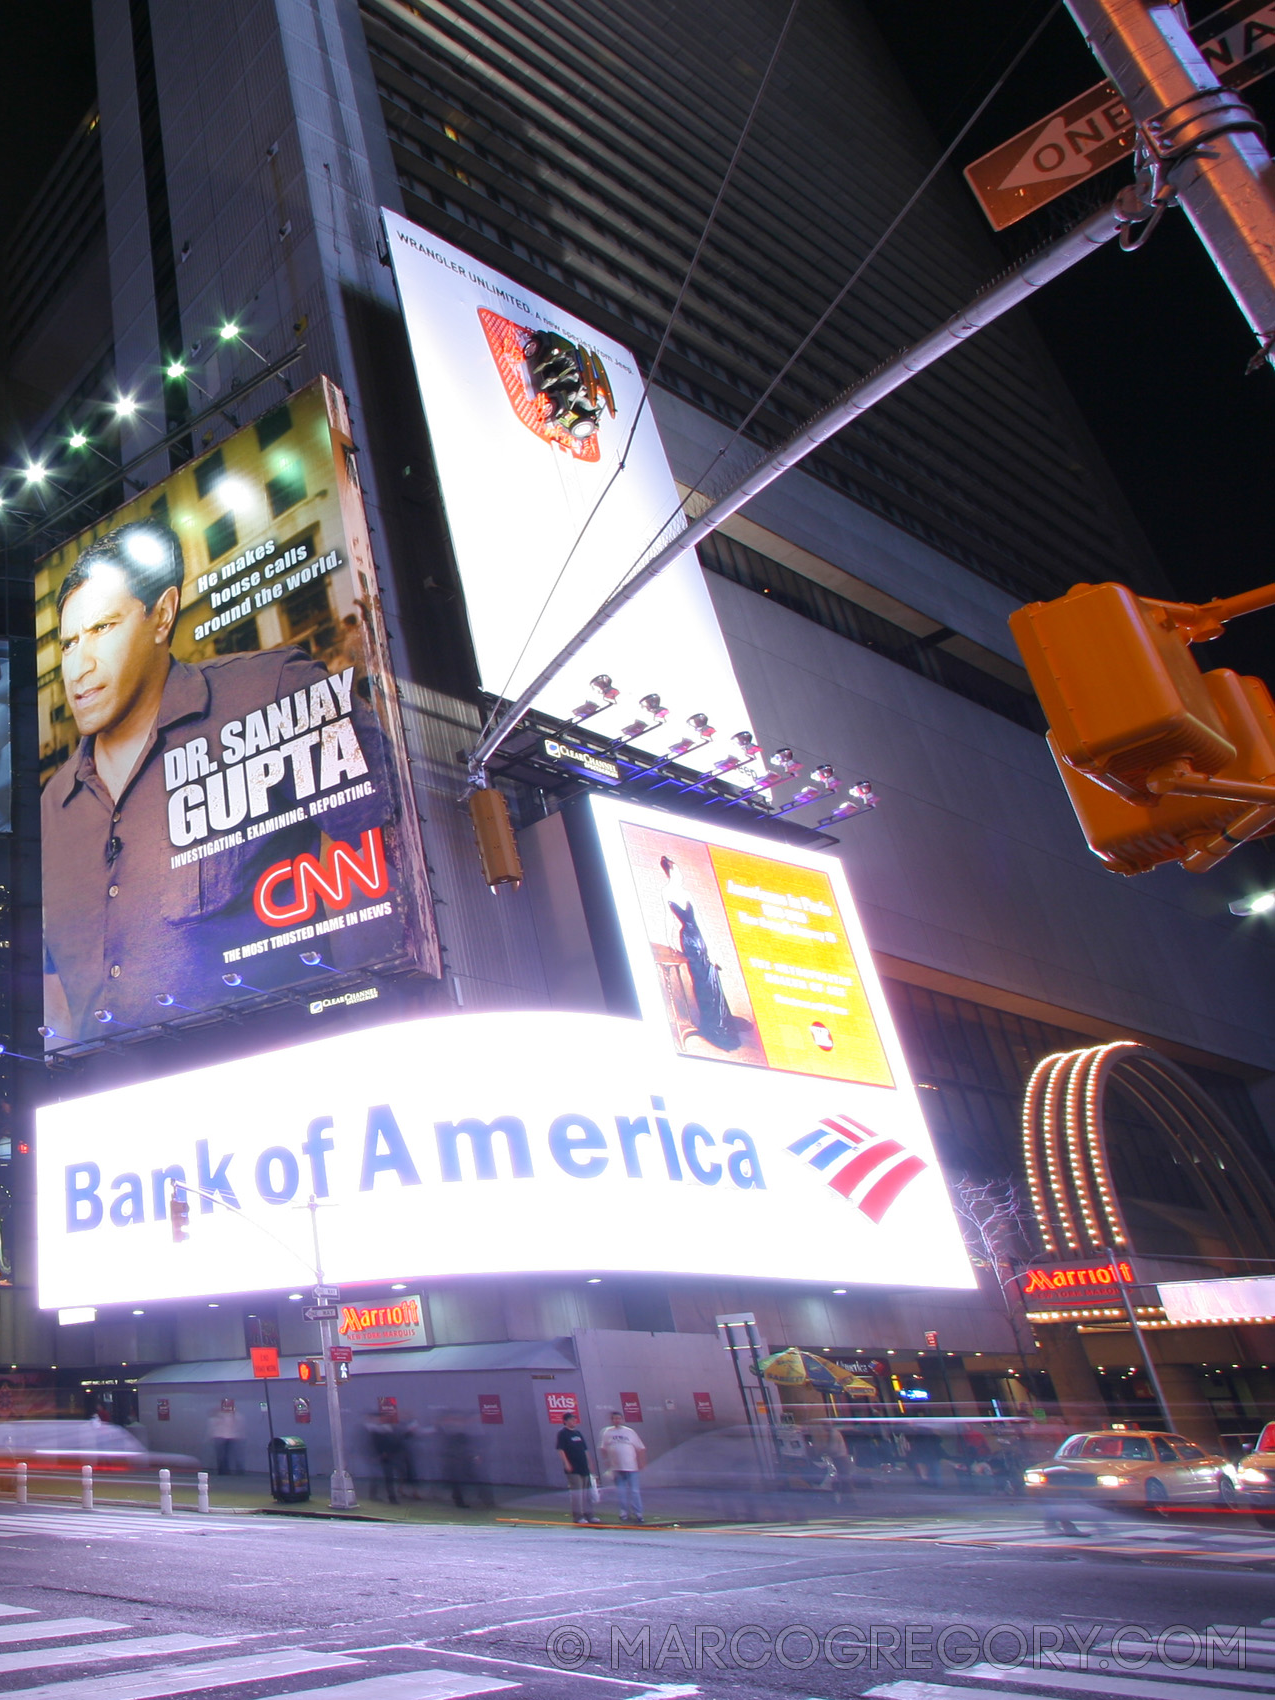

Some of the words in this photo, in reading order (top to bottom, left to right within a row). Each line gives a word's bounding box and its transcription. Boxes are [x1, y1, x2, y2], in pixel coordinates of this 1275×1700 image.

[1032, 101, 1130, 173] ONE
[397, 230, 466, 276] WRANGLER
[468, 271, 533, 315] UNLIMITED.
[535, 311, 542, 321] A
[543, 316, 561, 332] new
[592, 345, 614, 363] from
[193, 598, 252, 642] around
[255, 583, 283, 609] the
[285, 548, 343, 592] world.
[197, 566, 219, 594] He
[221, 538, 275, 583] makes
[211, 571, 261, 609] house
[265, 542, 308, 583] calls
[163, 737, 217, 792] DR.
[220, 667, 355, 764] SANJAY
[167, 717, 369, 848] GUPTA
[171, 833, 246, 869] INVESTIGATING.
[247, 809, 308, 843] EXAMINING.
[309, 780, 376, 816] REPORTING.
[253, 826, 390, 927] CNN
[223, 948, 241, 964] THE
[242, 940, 270, 960] MOST
[270, 926, 315, 952] TRUSTED
[316, 915, 346, 939] NAME
[346, 914, 357, 930] IN
[359, 902, 393, 926] NEWS
[63, 1136, 242, 1234] Bank
[254, 1115, 335, 1207] of
[359, 1094, 768, 1193] America
[1025, 1262, 1134, 1294] Marriott
[339, 1300, 420, 1335] Marriott
[347, 1333, 361, 1341] NEW
[363, 1331, 382, 1340] YORK
[383, 1329, 416, 1338] MARQUIS
[547, 1395, 575, 1409] tkts
